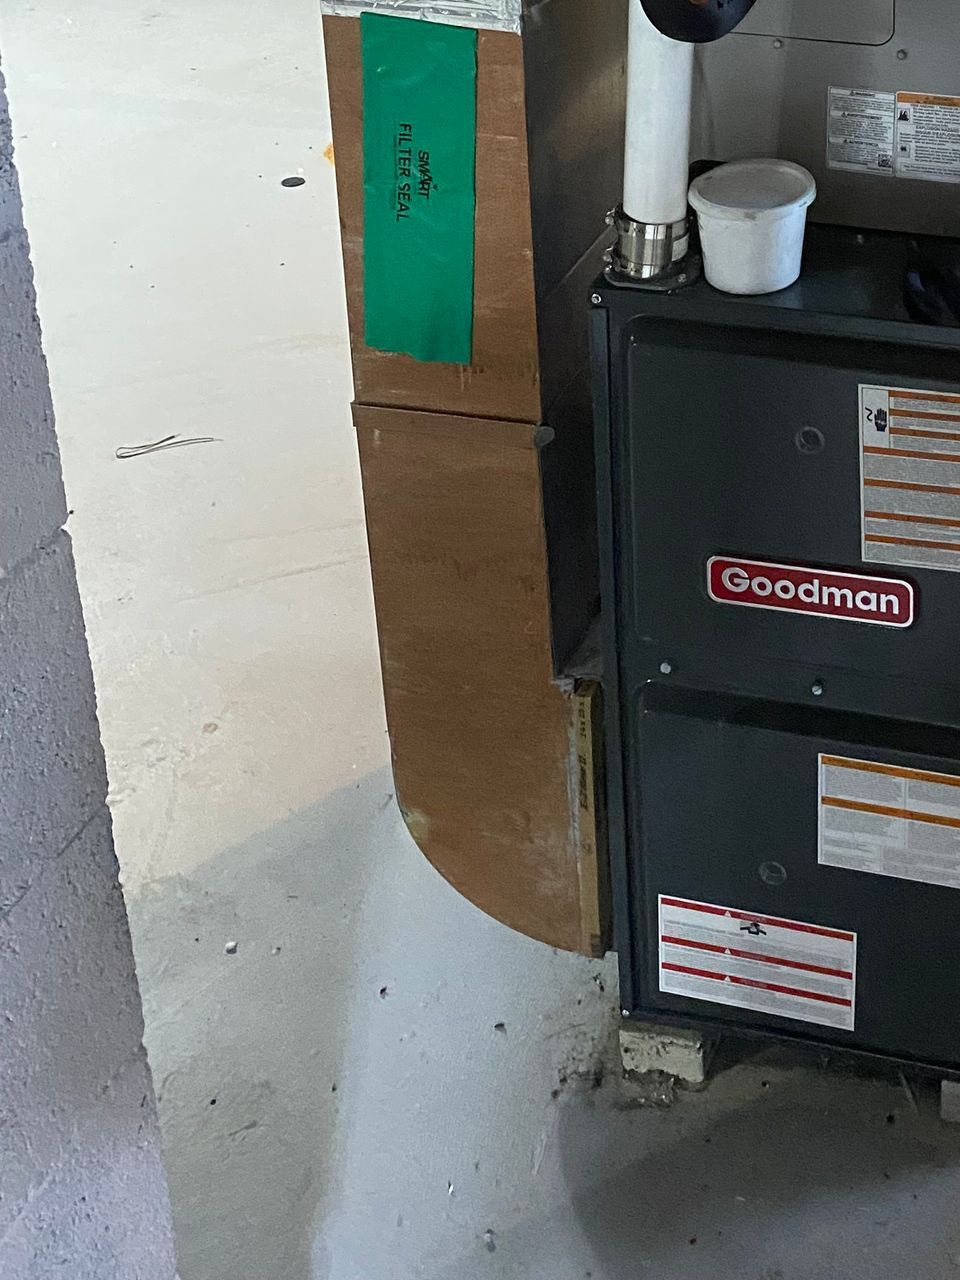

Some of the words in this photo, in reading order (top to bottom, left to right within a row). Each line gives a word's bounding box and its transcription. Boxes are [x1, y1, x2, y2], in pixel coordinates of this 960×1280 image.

[399, 124, 412, 177] FILTER
[419, 150, 432, 199] SMART
[397, 183, 411, 221] SEAL
[721, 567, 899, 614] Goodman
